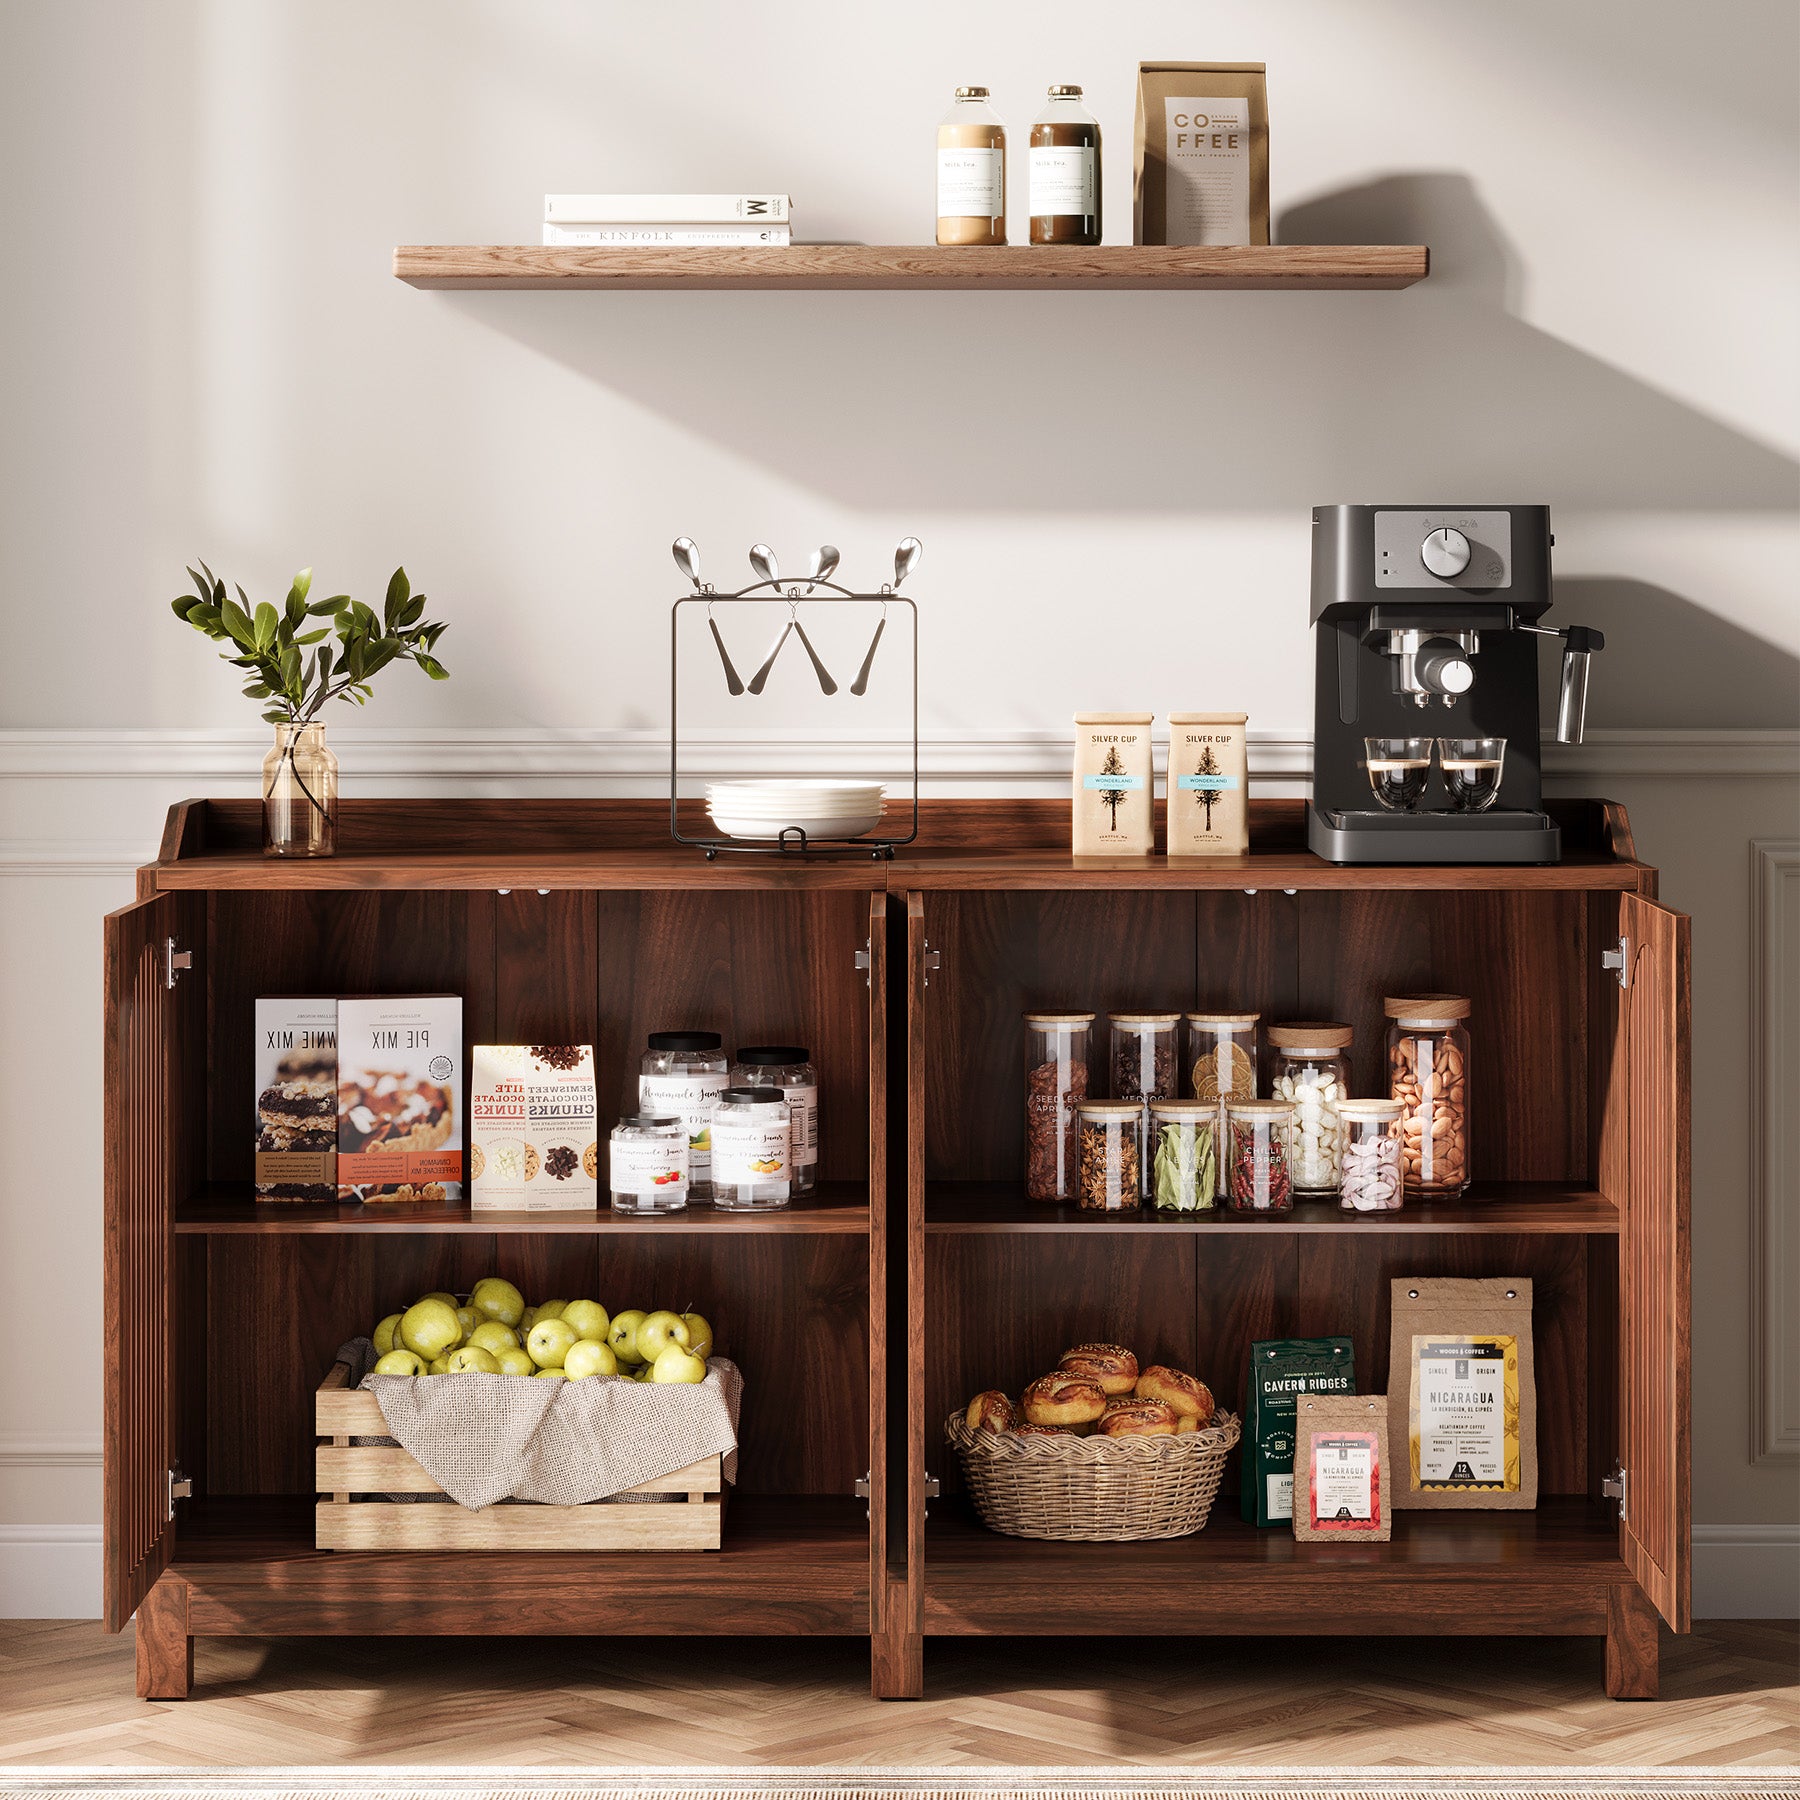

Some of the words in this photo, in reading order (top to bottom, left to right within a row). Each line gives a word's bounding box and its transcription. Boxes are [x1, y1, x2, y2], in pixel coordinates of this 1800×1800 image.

[1173, 113, 1210, 128] CO
[1177, 133, 1238, 149] FFEE
[747, 199, 768, 216] M
[600, 231, 674, 240] KINFOLK
[1091, 735, 1118, 743] SILVER
[1121, 735, 1138, 743] CUP
[1185, 735, 1213, 743] SILVER
[1215, 735, 1232, 743] CUP
[762, 1134, 784, 1143] Jams
[1264, 1379, 1306, 1393] CAVERN
[1309, 1377, 1348, 1390] RIDGES
[1430, 1391, 1494, 1404] NICARAGUA
[1322, 1467, 1364, 1475] NICARAGUA
[1457, 1464, 1467, 1473] 12
